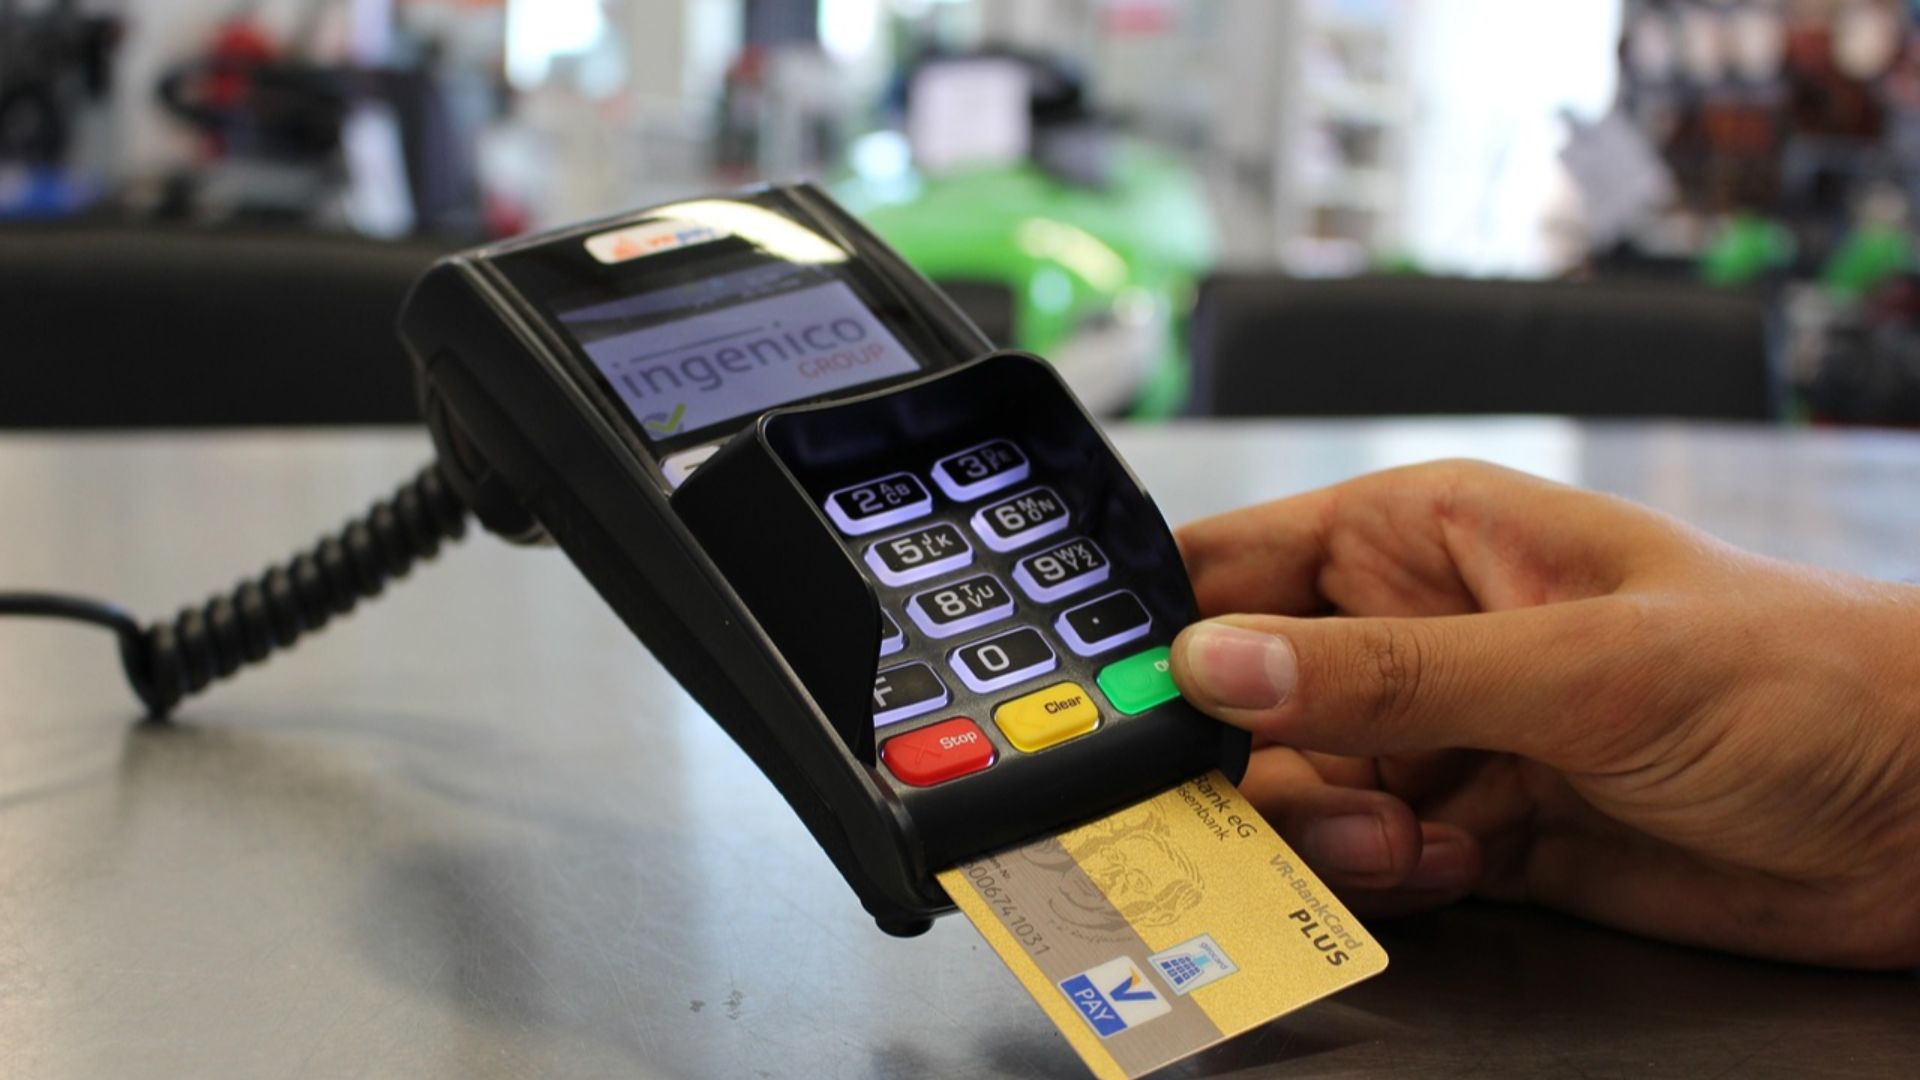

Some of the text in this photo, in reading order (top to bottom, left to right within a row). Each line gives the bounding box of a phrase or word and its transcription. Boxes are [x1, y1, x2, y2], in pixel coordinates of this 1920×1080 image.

[610, 317, 867, 399] ingenico
[796, 341, 885, 380] GROUP
[958, 455, 989, 478] 3
[851, 489, 884, 514] 2
[994, 505, 1026, 530] 6
[890, 537, 925, 564] 5
[1033, 555, 1067, 581] 9
[934, 590, 967, 616] 8
[976, 644, 1010, 672] 0
[1043, 694, 1082, 715] Clear
[939, 730, 978, 750] Stop
[1227, 815, 1258, 838] eG
[1269, 853, 1364, 950] VR-BankCard
[1288, 908, 1350, 966] PLUS
[1074, 987, 1115, 1022] PAY
